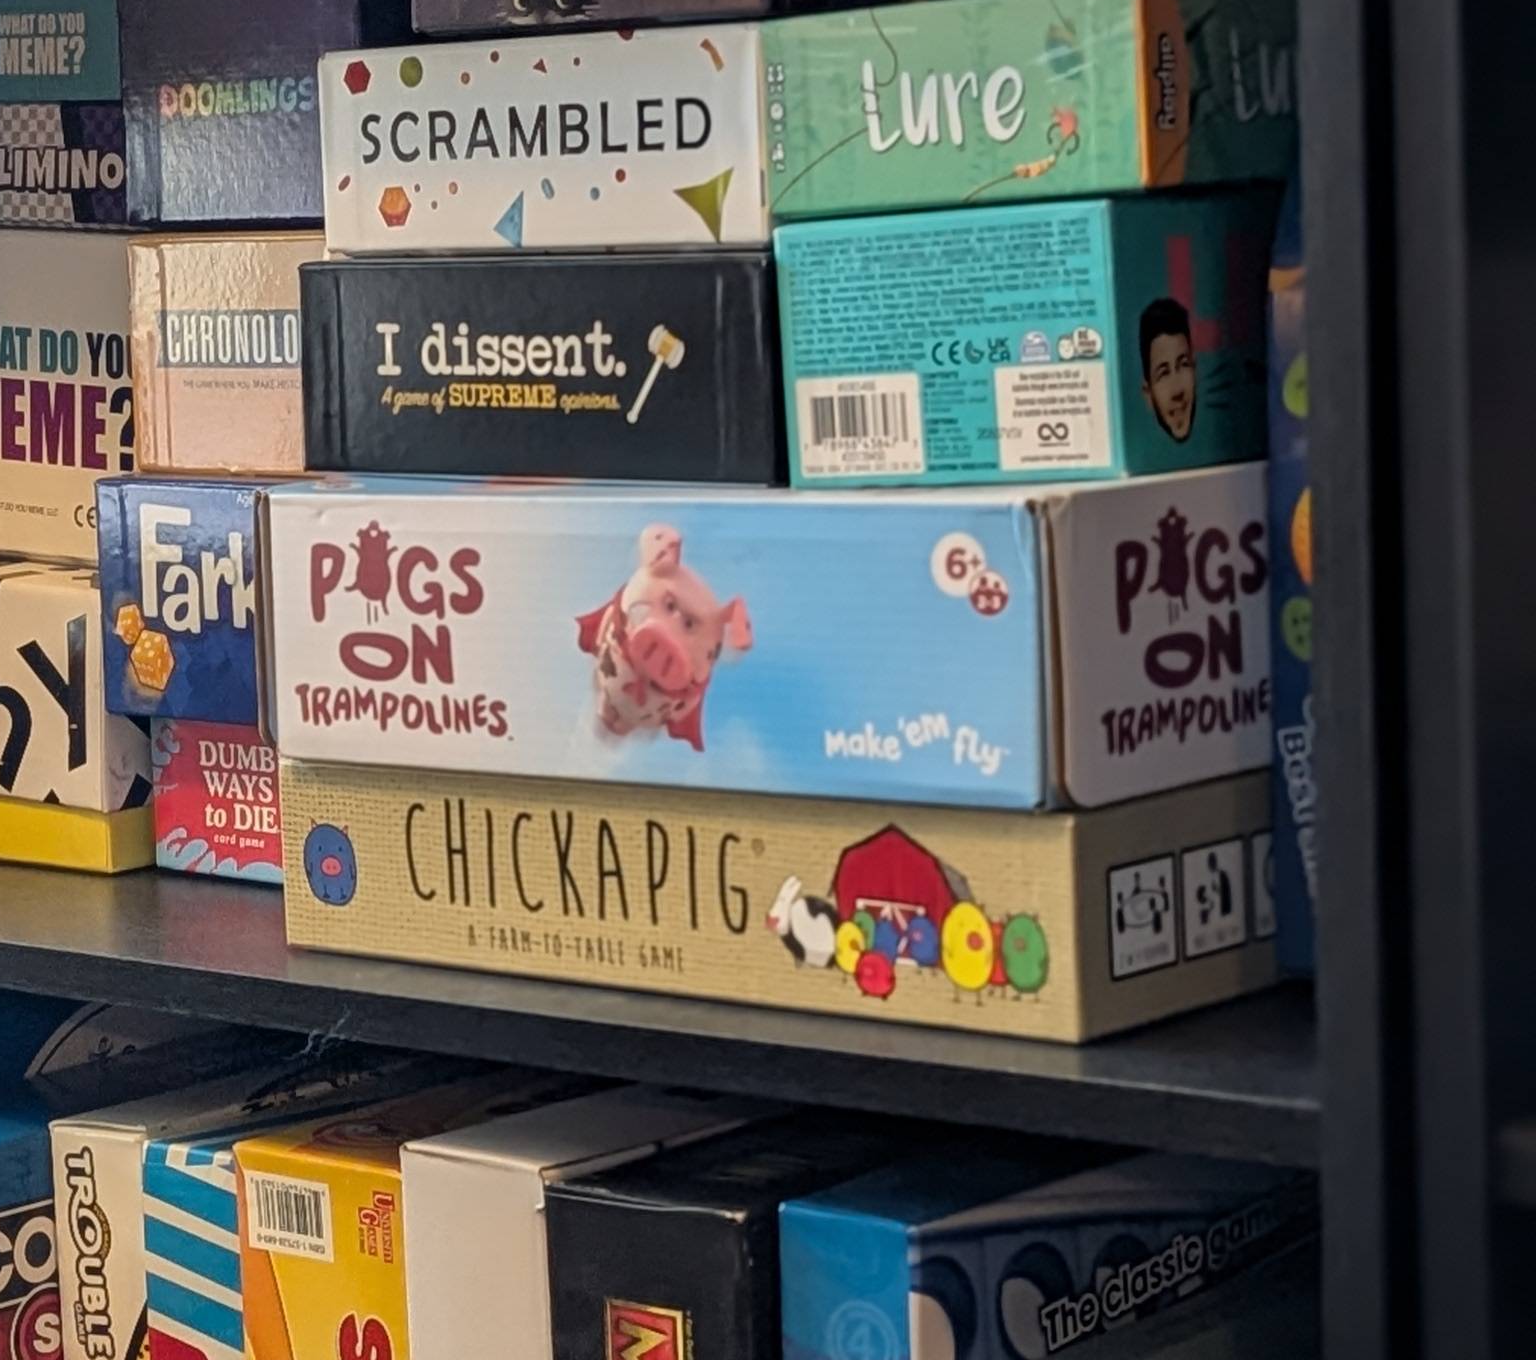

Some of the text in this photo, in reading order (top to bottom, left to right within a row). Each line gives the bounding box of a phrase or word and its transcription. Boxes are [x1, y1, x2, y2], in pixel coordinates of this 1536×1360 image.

[38, 13, 57, 35] DO
[58, 11, 86, 34] YOU
[158, 77, 314, 119] DOOMLINGS
[861, 58, 1027, 155] Lure
[361, 96, 713, 165] SCRAMBLED
[38, 330, 79, 376] DO
[376, 320, 627, 378] I dissent.
[381, 382, 621, 414] A game of SUPREME opinions.
[945, 546, 983, 581] 6+
[339, 622, 455, 685] ON
[1144, 609, 1242, 688] ON
[295, 682, 510, 738] TRAMPOLINES
[199, 740, 276, 774] DUMB
[954, 725, 1004, 776] fly
[203, 771, 274, 803] WAYS
[204, 800, 278, 834] to DIE
[213, 833, 266, 849] card game
[405, 796, 749, 935] CHICKAPIG
[488, 926, 685, 974] FARM-TO-TABLE GAME
[64, 1144, 115, 1360] TROUBLE
[373, 1190, 395, 1265] UNIVERSITY
[1040, 1232, 1204, 1354] The classic
[74, 1302, 88, 1347] GAME
